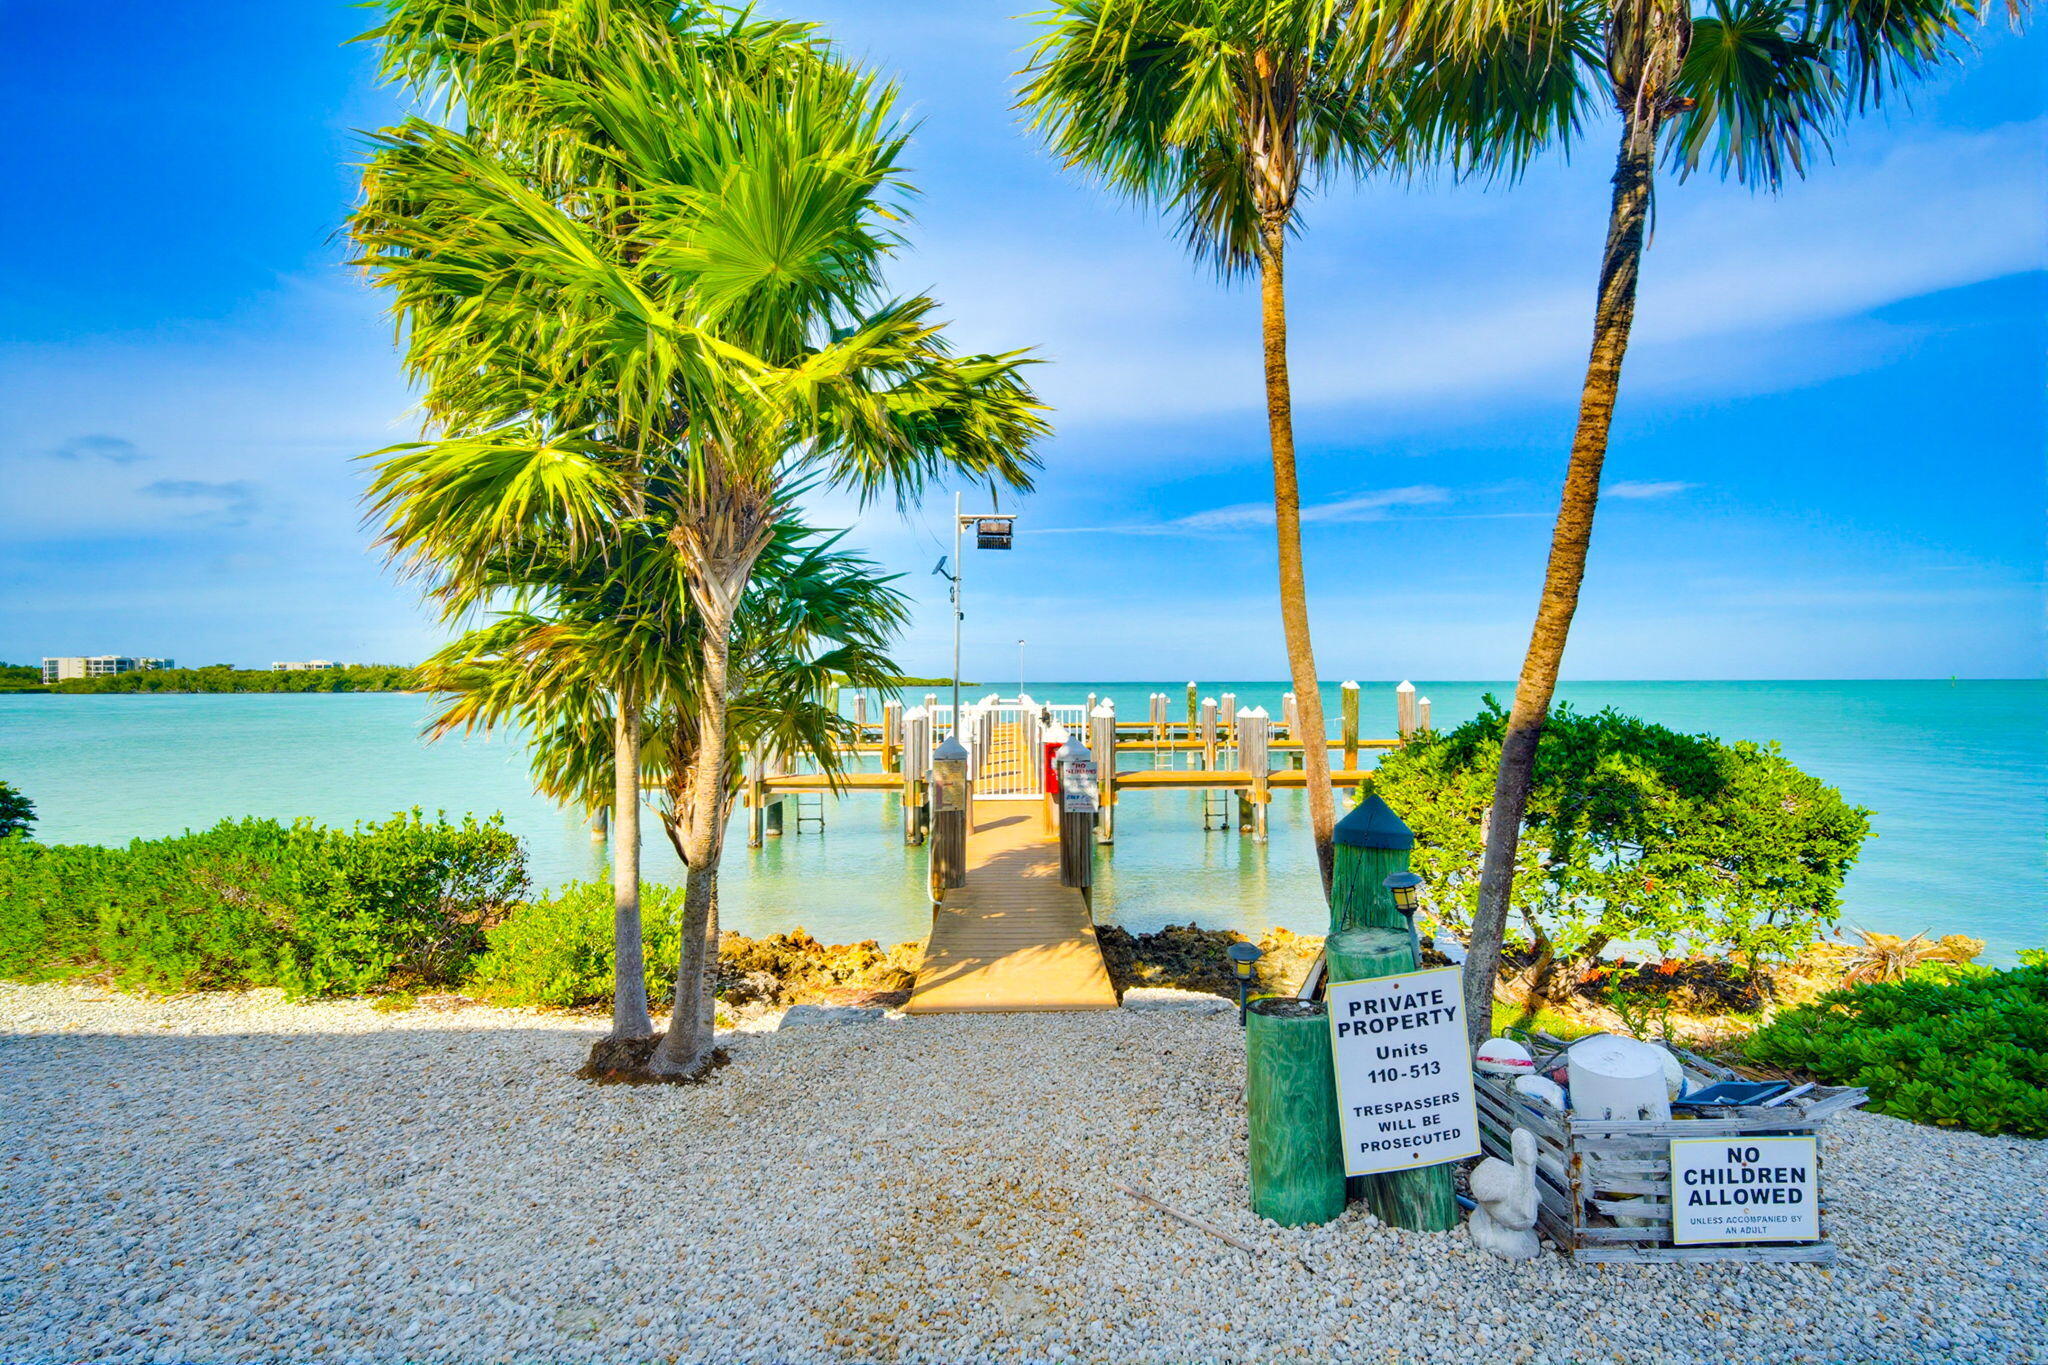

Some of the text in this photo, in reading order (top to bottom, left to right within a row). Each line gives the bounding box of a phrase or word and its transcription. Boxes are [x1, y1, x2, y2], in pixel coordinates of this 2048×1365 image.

[1349, 989, 1444, 1017] PRIVATE
[1338, 1006, 1457, 1038] PROPERTY
[1376, 1043, 1428, 1060] Units
[1353, 1092, 1460, 1118] TRESPASSERS
[1378, 1114, 1441, 1133] WILL BE
[1360, 1128, 1461, 1153] PROSECUTED
[1727, 1146, 1760, 1163] NO
[1684, 1168, 1806, 1186] CHILDREN
[1688, 1188, 1803, 1206] ALLOWED
[1690, 1215, 1803, 1225] UNLESS ACCOMPANIED BY
[1725, 1226, 1768, 1234] AN ADULT
